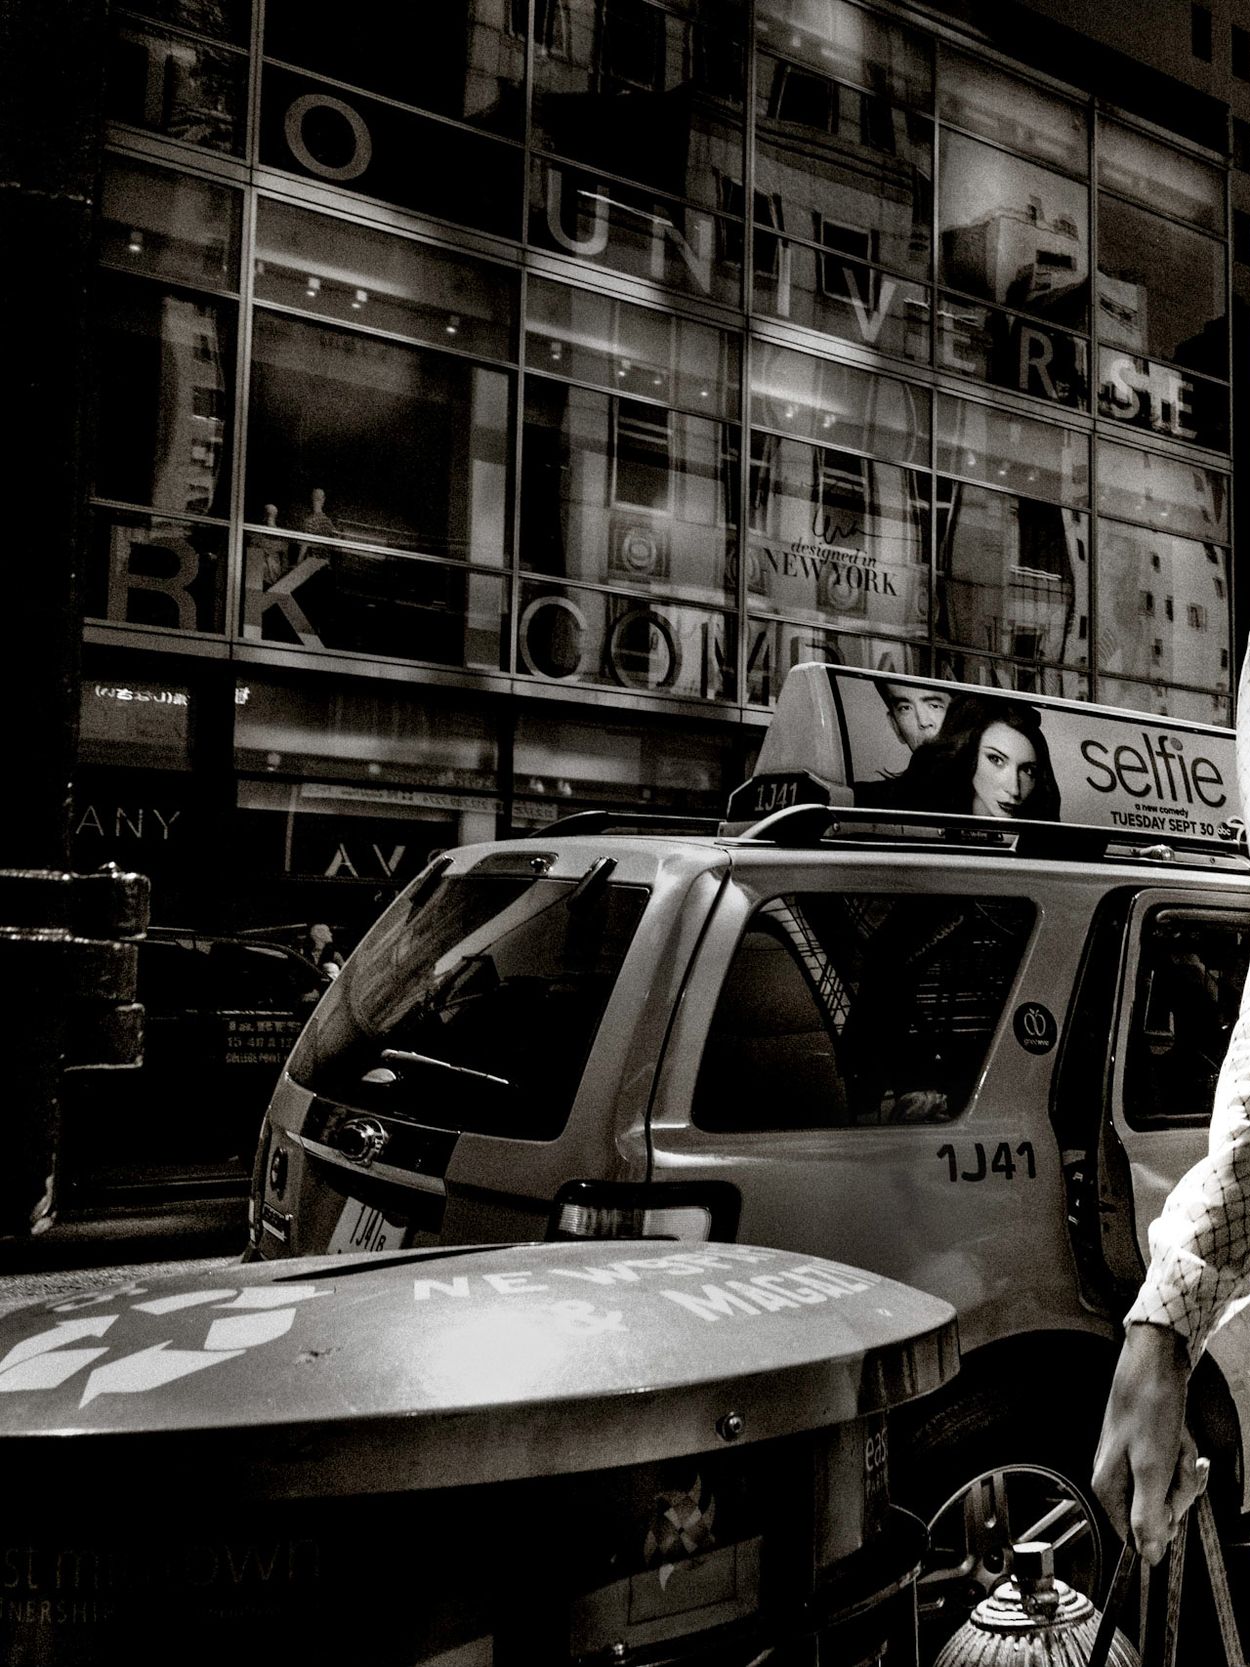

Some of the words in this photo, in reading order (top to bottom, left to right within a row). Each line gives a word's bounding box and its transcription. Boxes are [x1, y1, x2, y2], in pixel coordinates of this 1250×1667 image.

[546, 167, 1197, 440] UNIVERSE
[790, 537, 862, 565] designed
[861, 551, 877, 569] in
[762, 547, 823, 583] NEW
[829, 561, 898, 597] YORK
[1080, 732, 1227, 808] selfie
[754, 782, 798, 812] 1J41
[1134, 803, 1141, 811] a
[1142, 805, 1158, 813] new
[1159, 806, 1189, 819] comedy
[1110, 811, 1167, 831] TUESDAY
[1169, 817, 1198, 834] SEPT
[1199, 822, 1214, 836] 30
[936, 1141, 1036, 1182] 1J41
